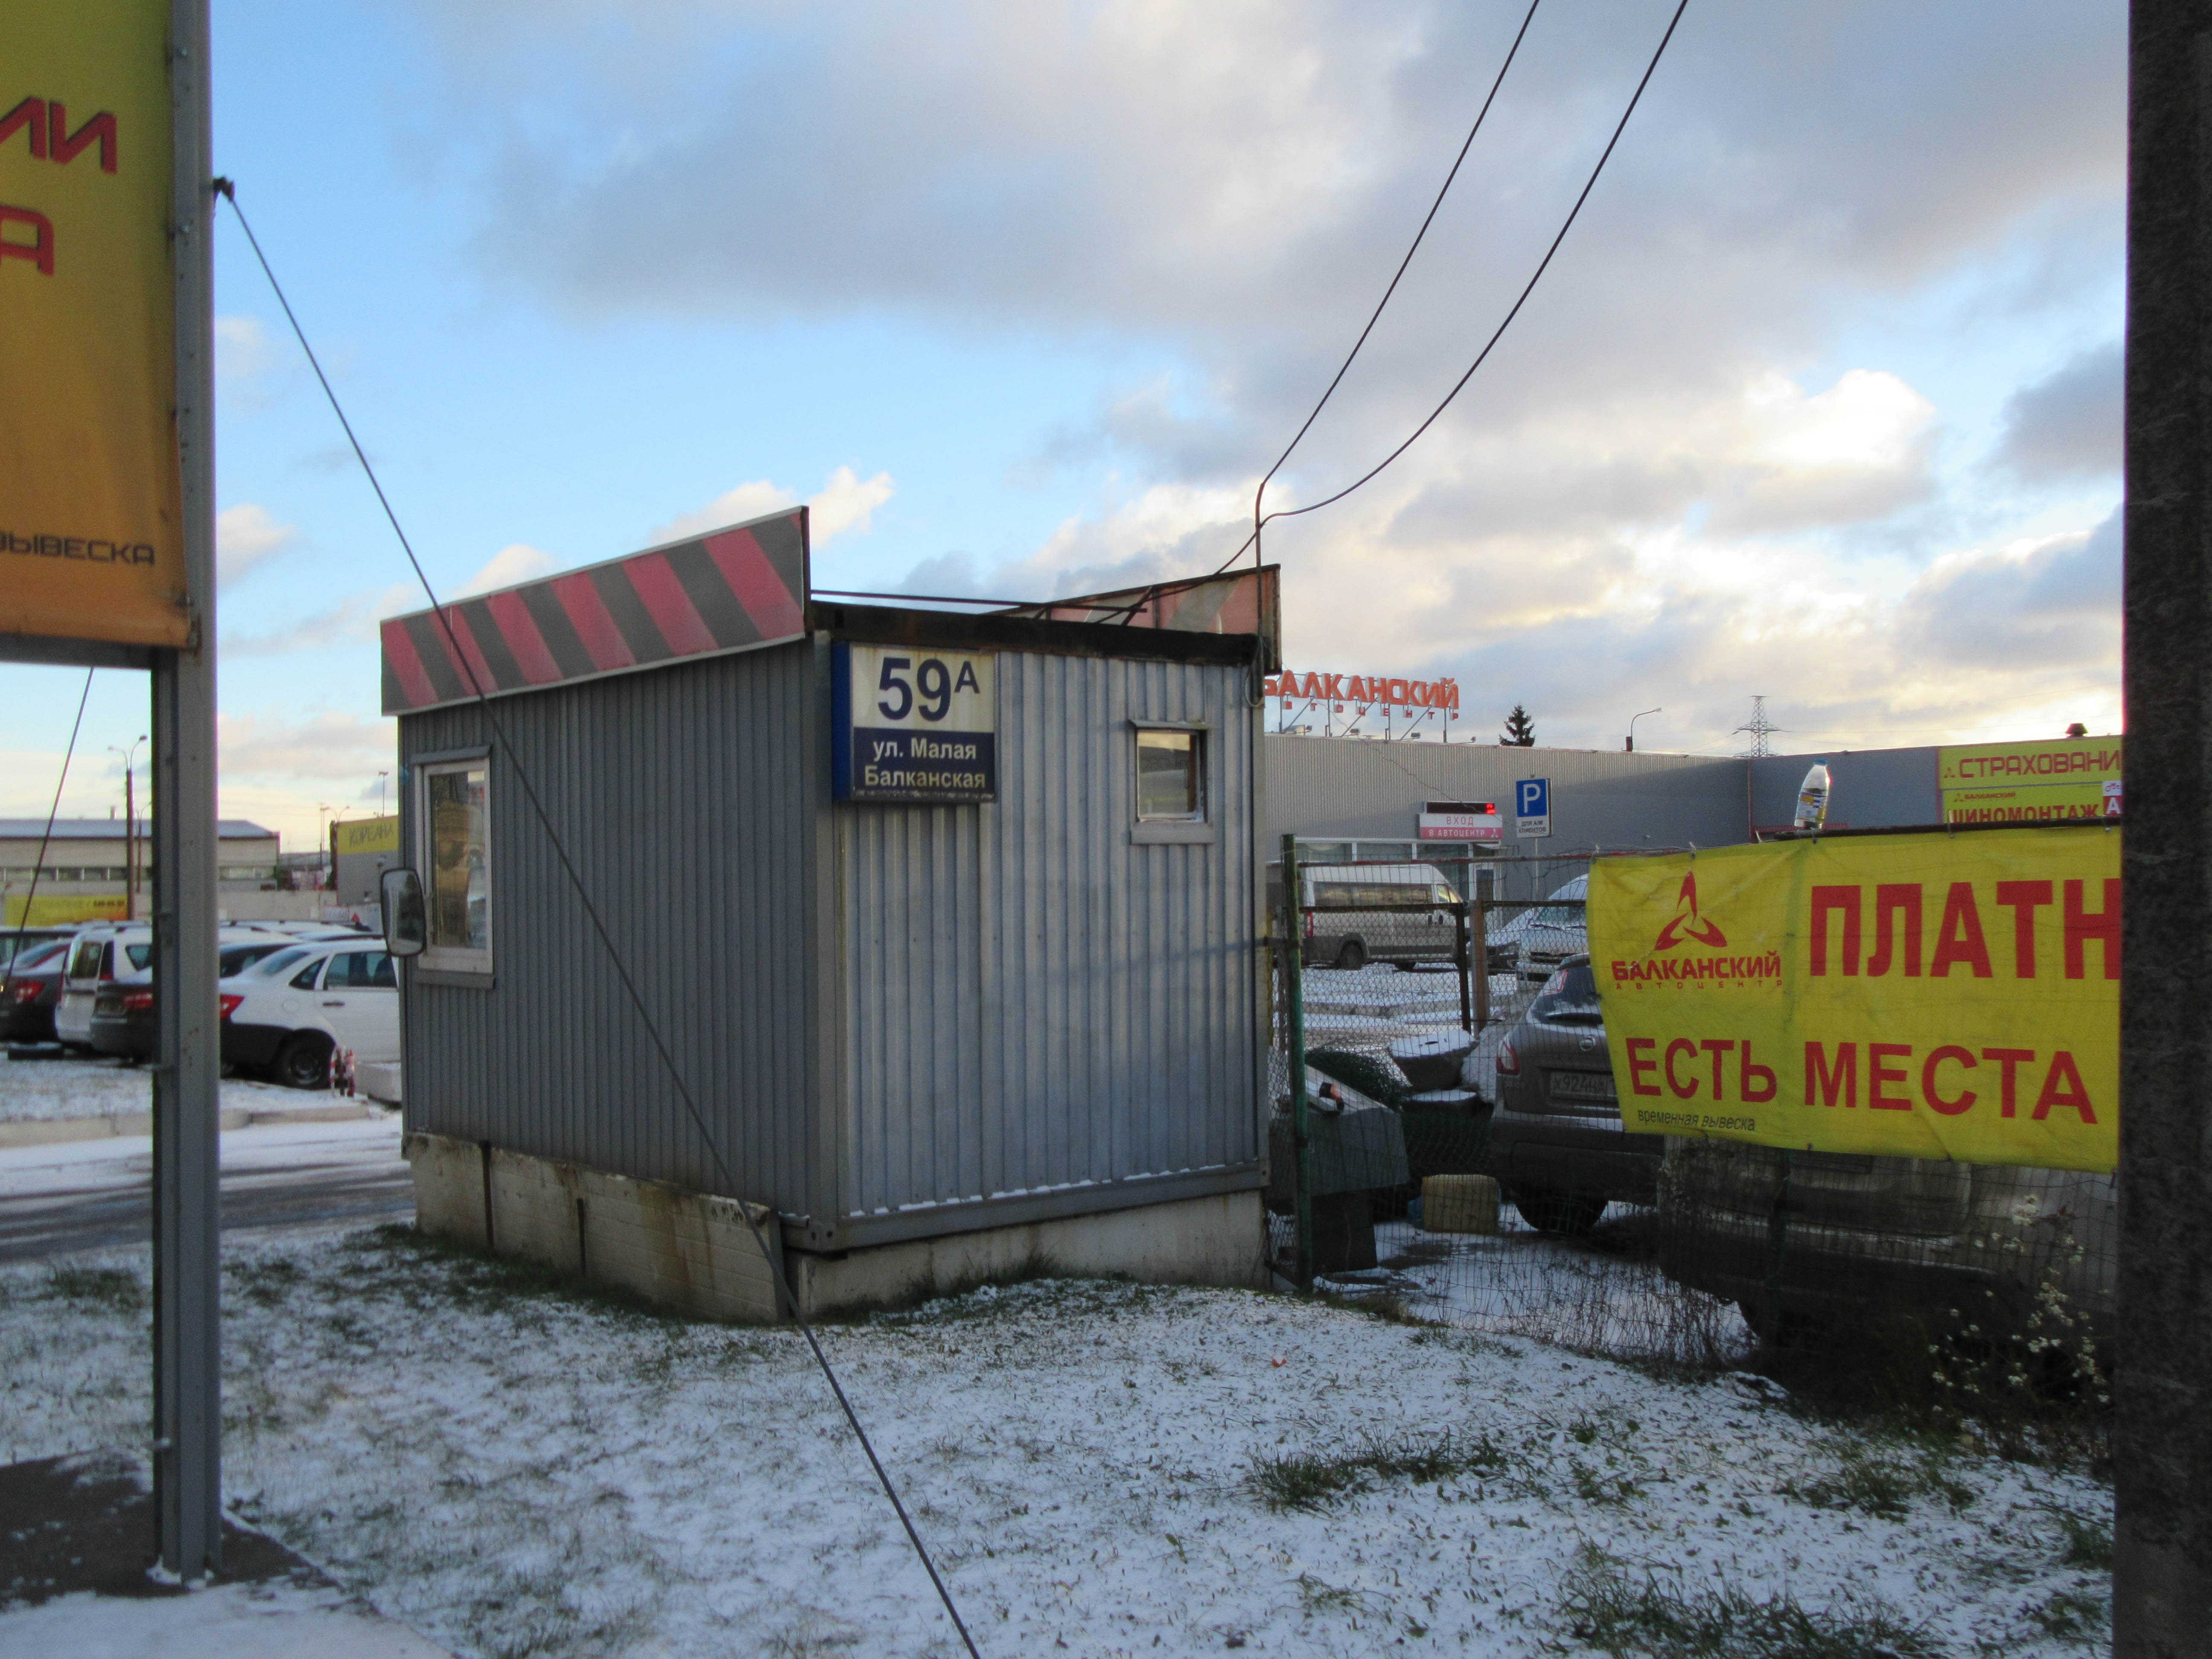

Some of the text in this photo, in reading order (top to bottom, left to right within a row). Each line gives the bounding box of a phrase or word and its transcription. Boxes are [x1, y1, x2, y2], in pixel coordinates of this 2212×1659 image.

[873, 737, 977, 762] ул. Малая
[864, 764, 986, 789] Балканская
[1438, 829, 1485, 837] АВТОЦЕНТР
[1446, 816, 1474, 826] ВХОД
[1810, 878, 2122, 980] ПЛАТН
[1612, 950, 1781, 981] БАЛКАНСКИЙ
[1616, 981, 1782, 990] АВТОЦЕНТР
[1626, 1038, 2098, 1124] ЕСТЬ МЕСТА
[1638, 1110, 1755, 1131] временная вывеска
